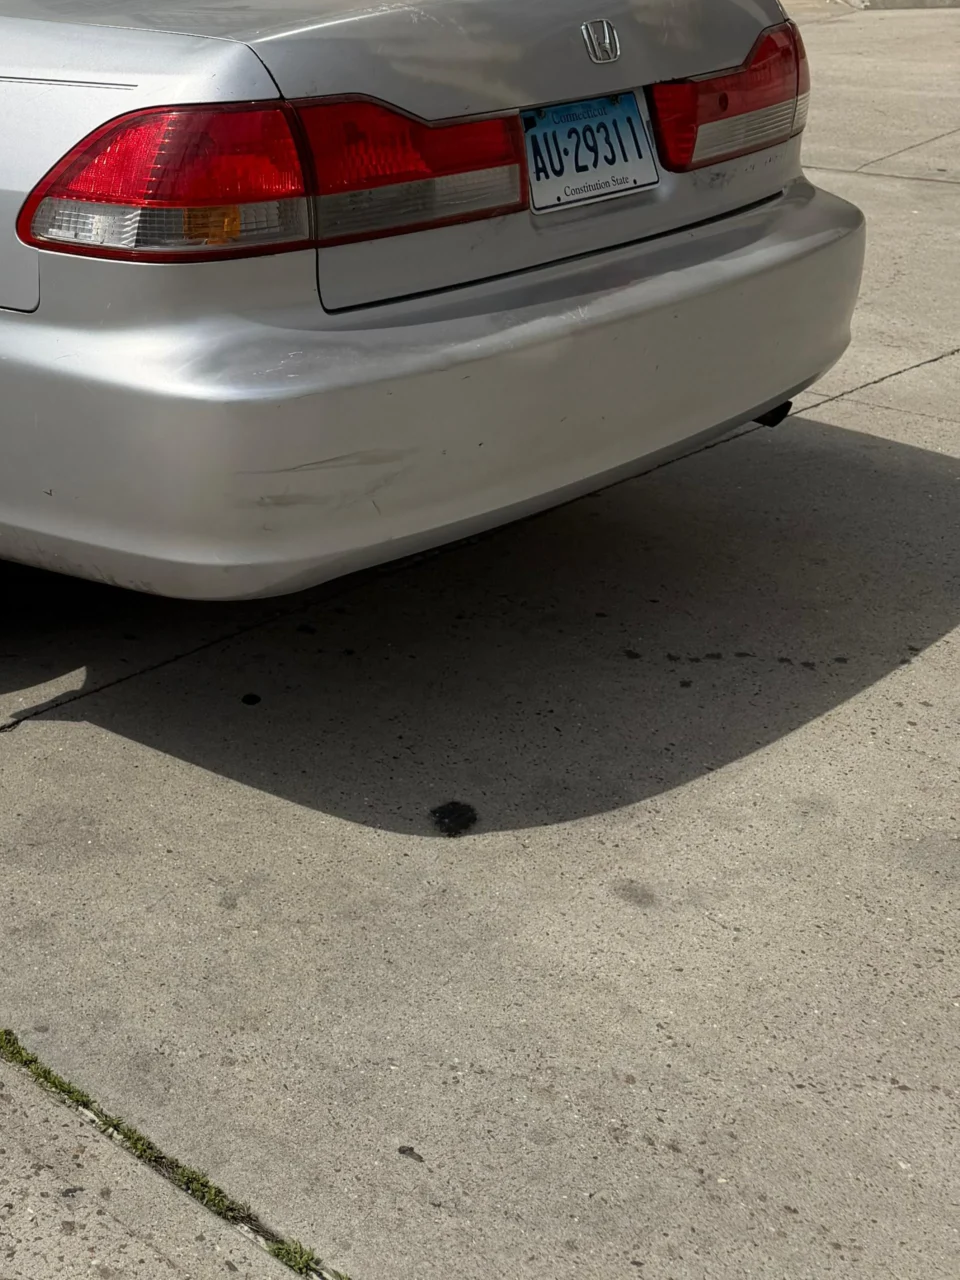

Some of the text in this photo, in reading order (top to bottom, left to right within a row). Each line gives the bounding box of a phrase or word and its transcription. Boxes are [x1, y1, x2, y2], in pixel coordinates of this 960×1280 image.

[551, 106, 608, 125] Connecticut
[563, 175, 629, 197] Constitution State
